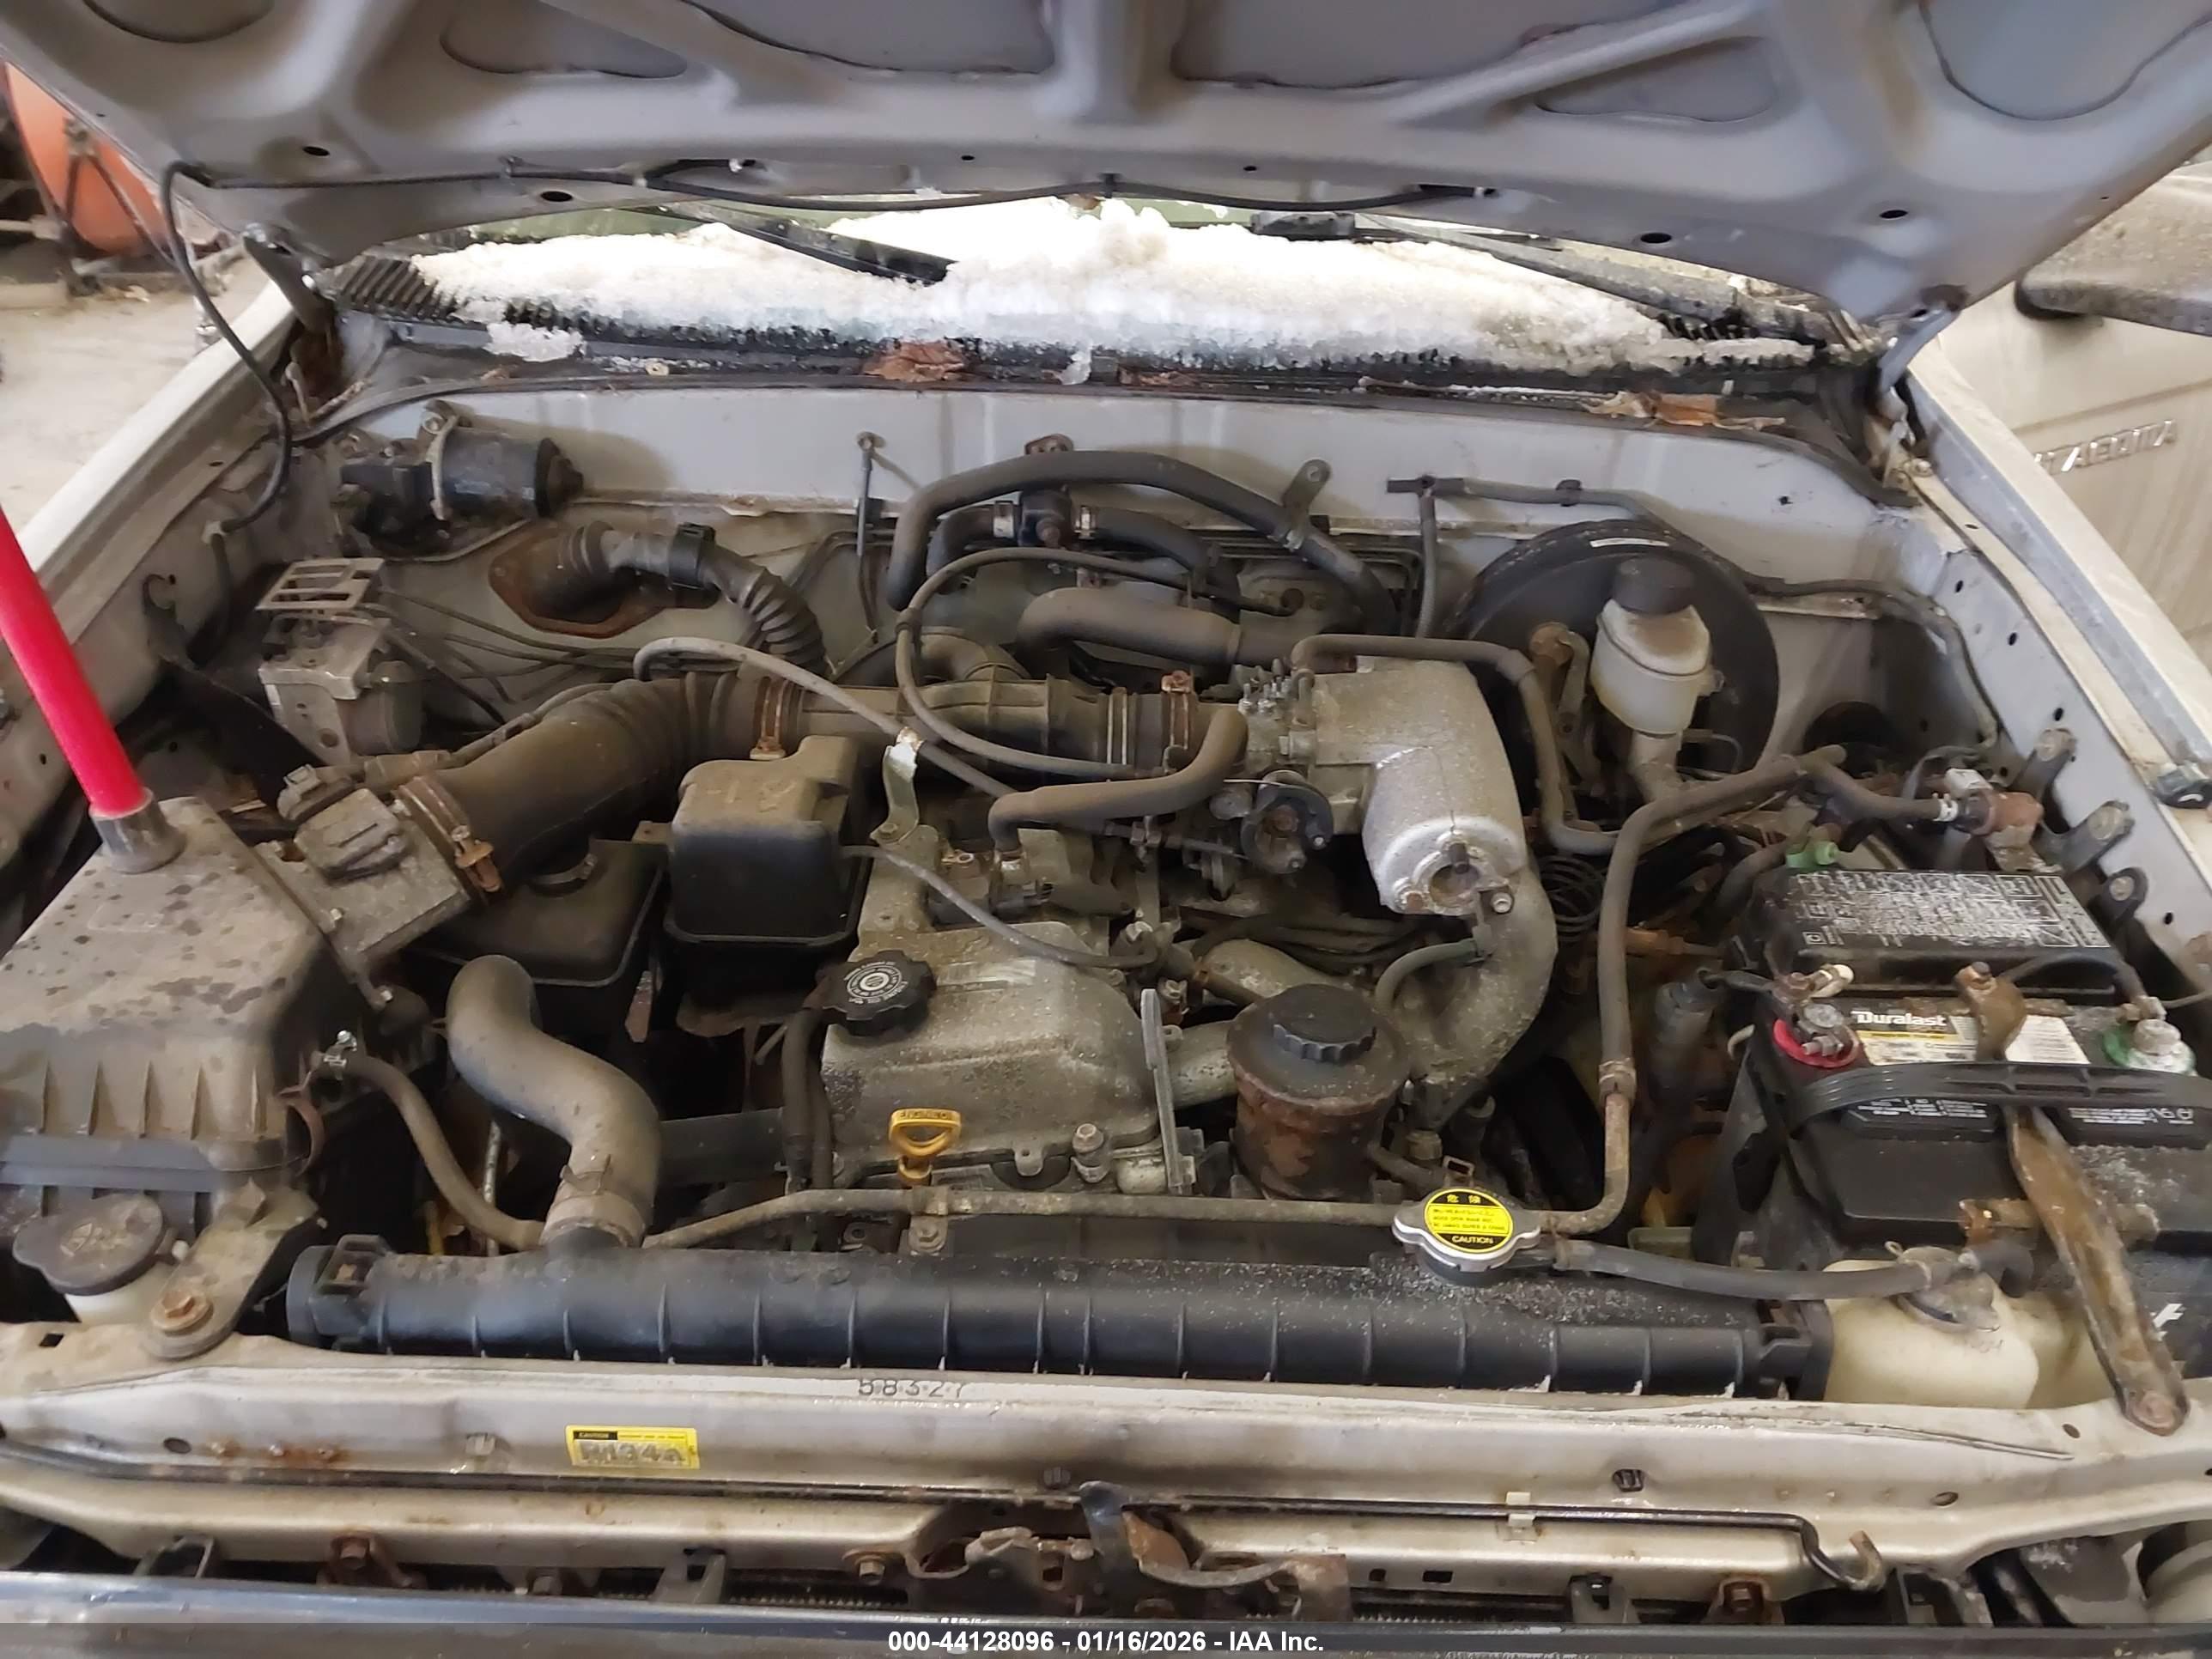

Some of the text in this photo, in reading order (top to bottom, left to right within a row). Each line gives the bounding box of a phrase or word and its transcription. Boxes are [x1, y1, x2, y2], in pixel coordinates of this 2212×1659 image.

[1850, 1011, 1948, 1026] Duralast
[1452, 1236, 1494, 1244] CAUTION
[859, 1379, 963, 1398] 58327
